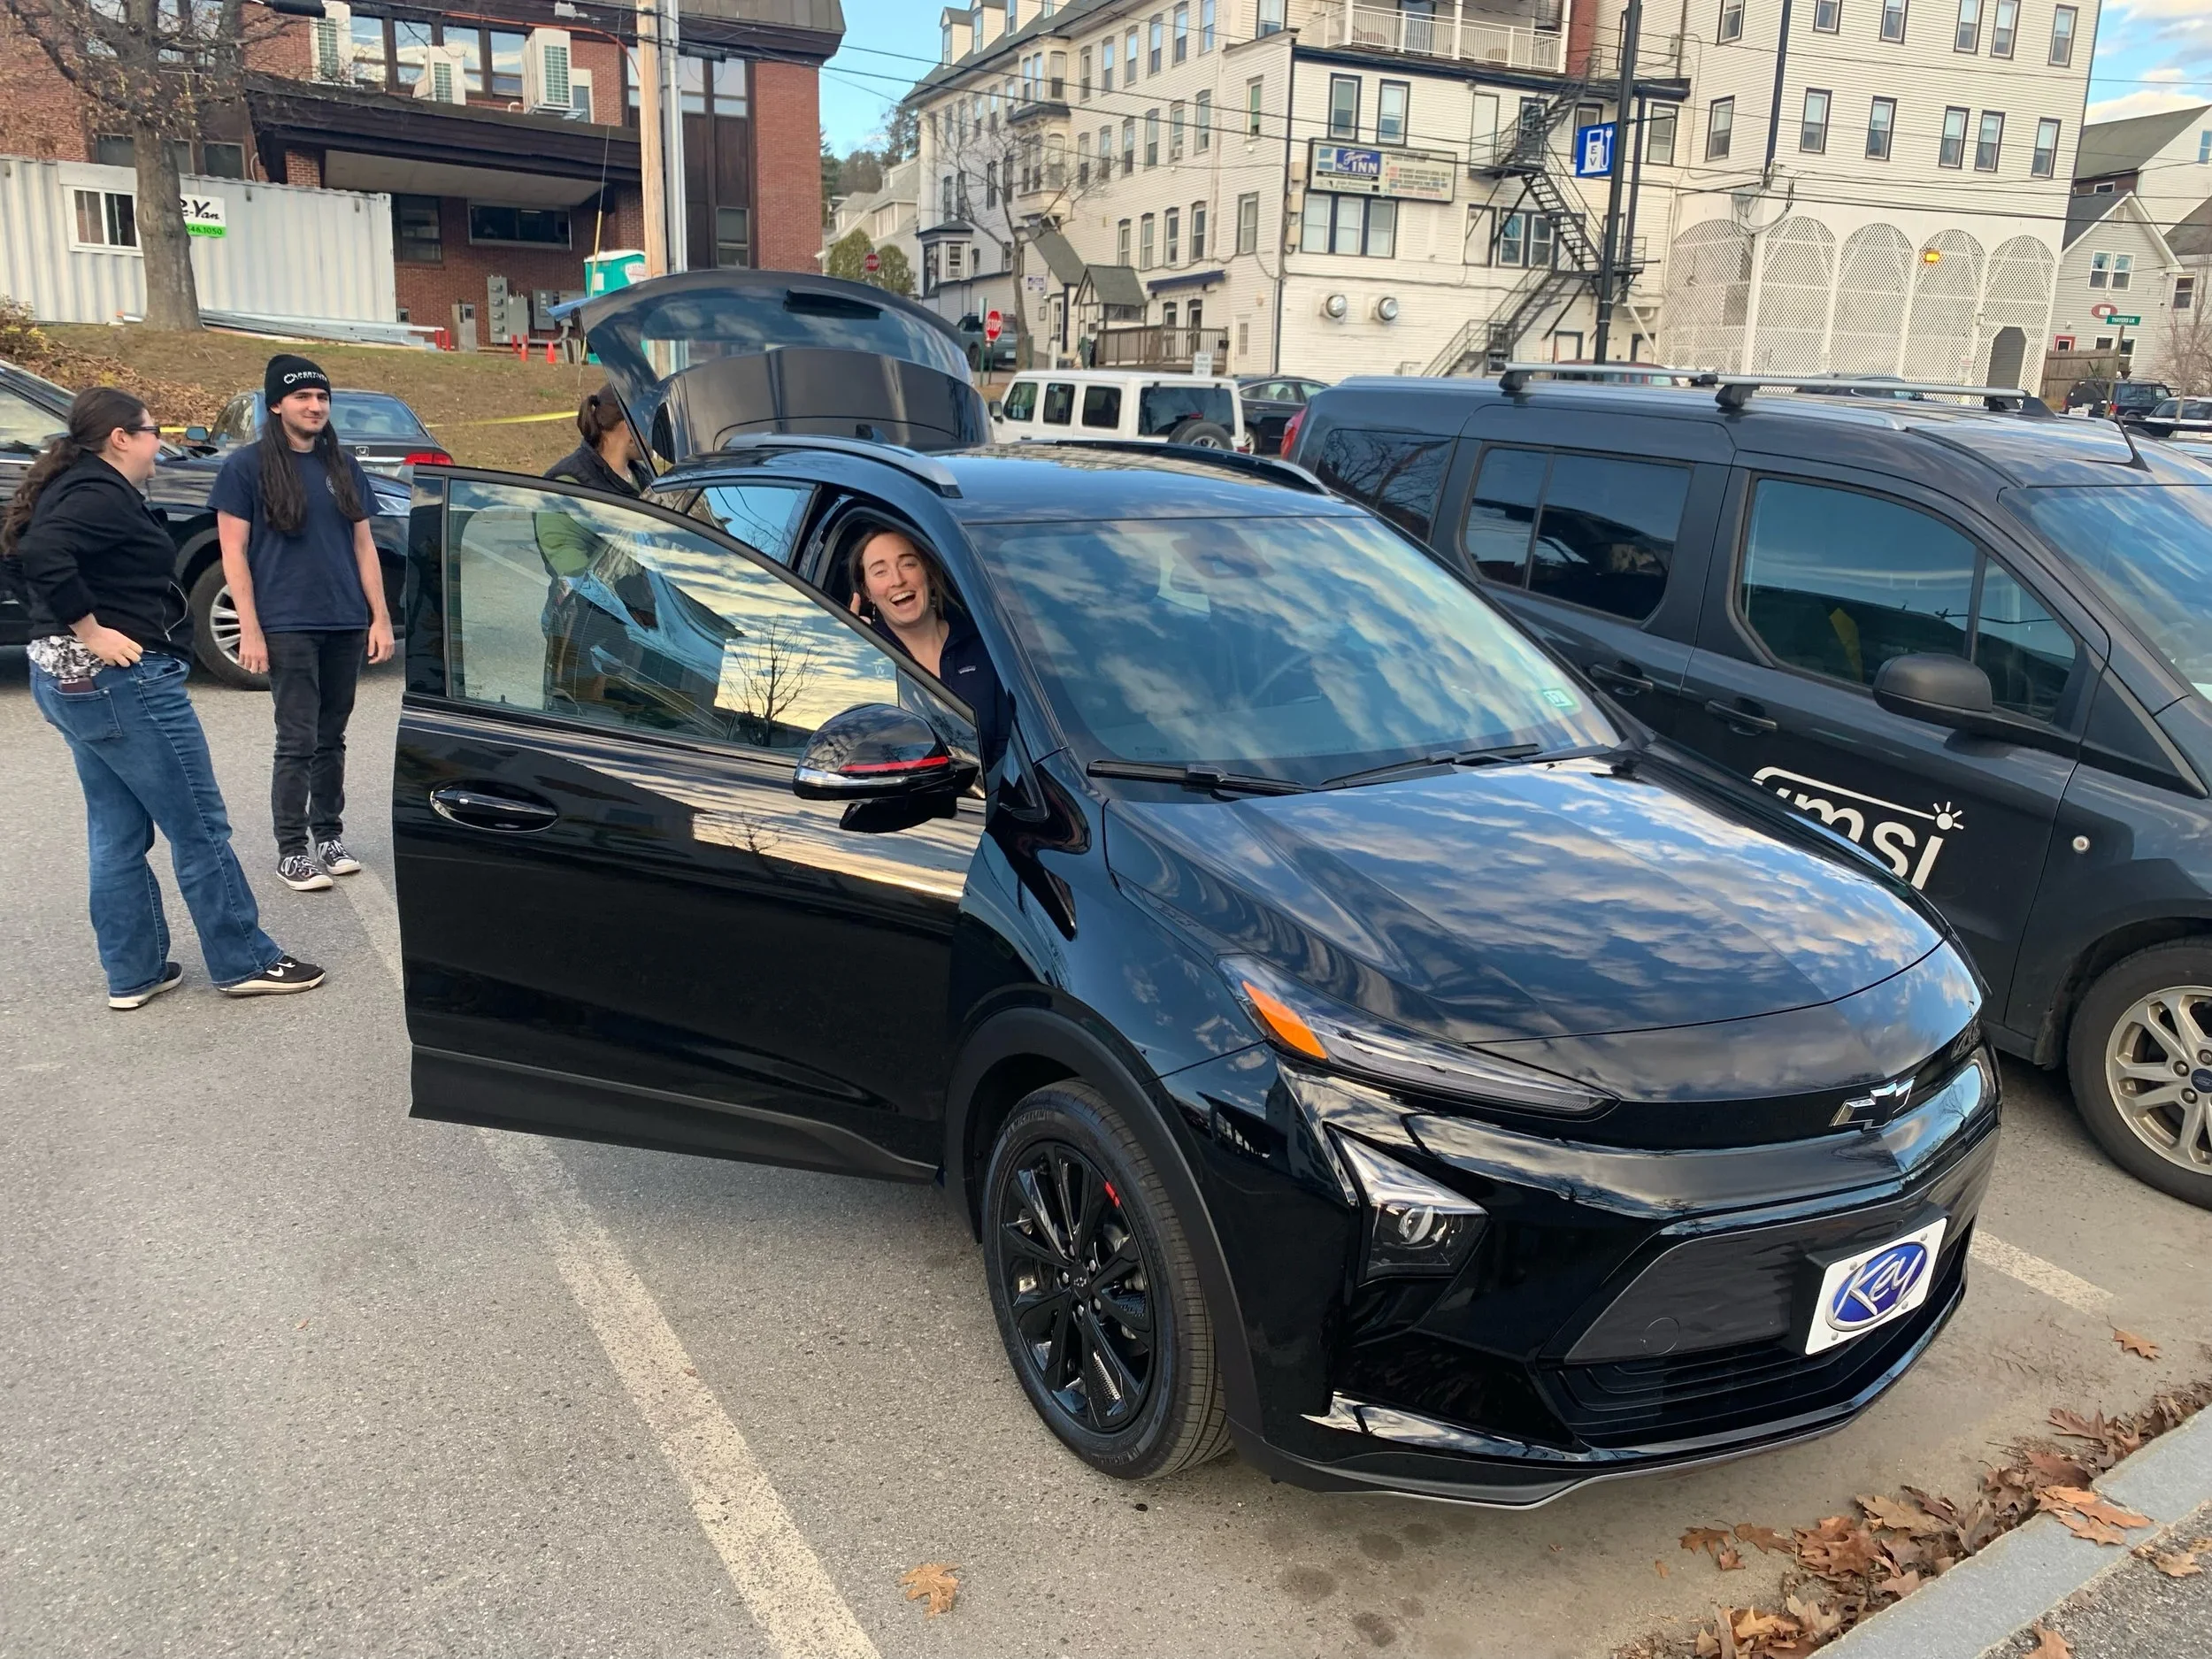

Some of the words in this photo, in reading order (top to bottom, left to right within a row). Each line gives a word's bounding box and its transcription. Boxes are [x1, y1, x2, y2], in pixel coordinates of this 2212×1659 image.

[1352, 161, 1378, 174] INN
[987, 319, 1002, 331] STOP
[1834, 1249, 1924, 1320] Key
